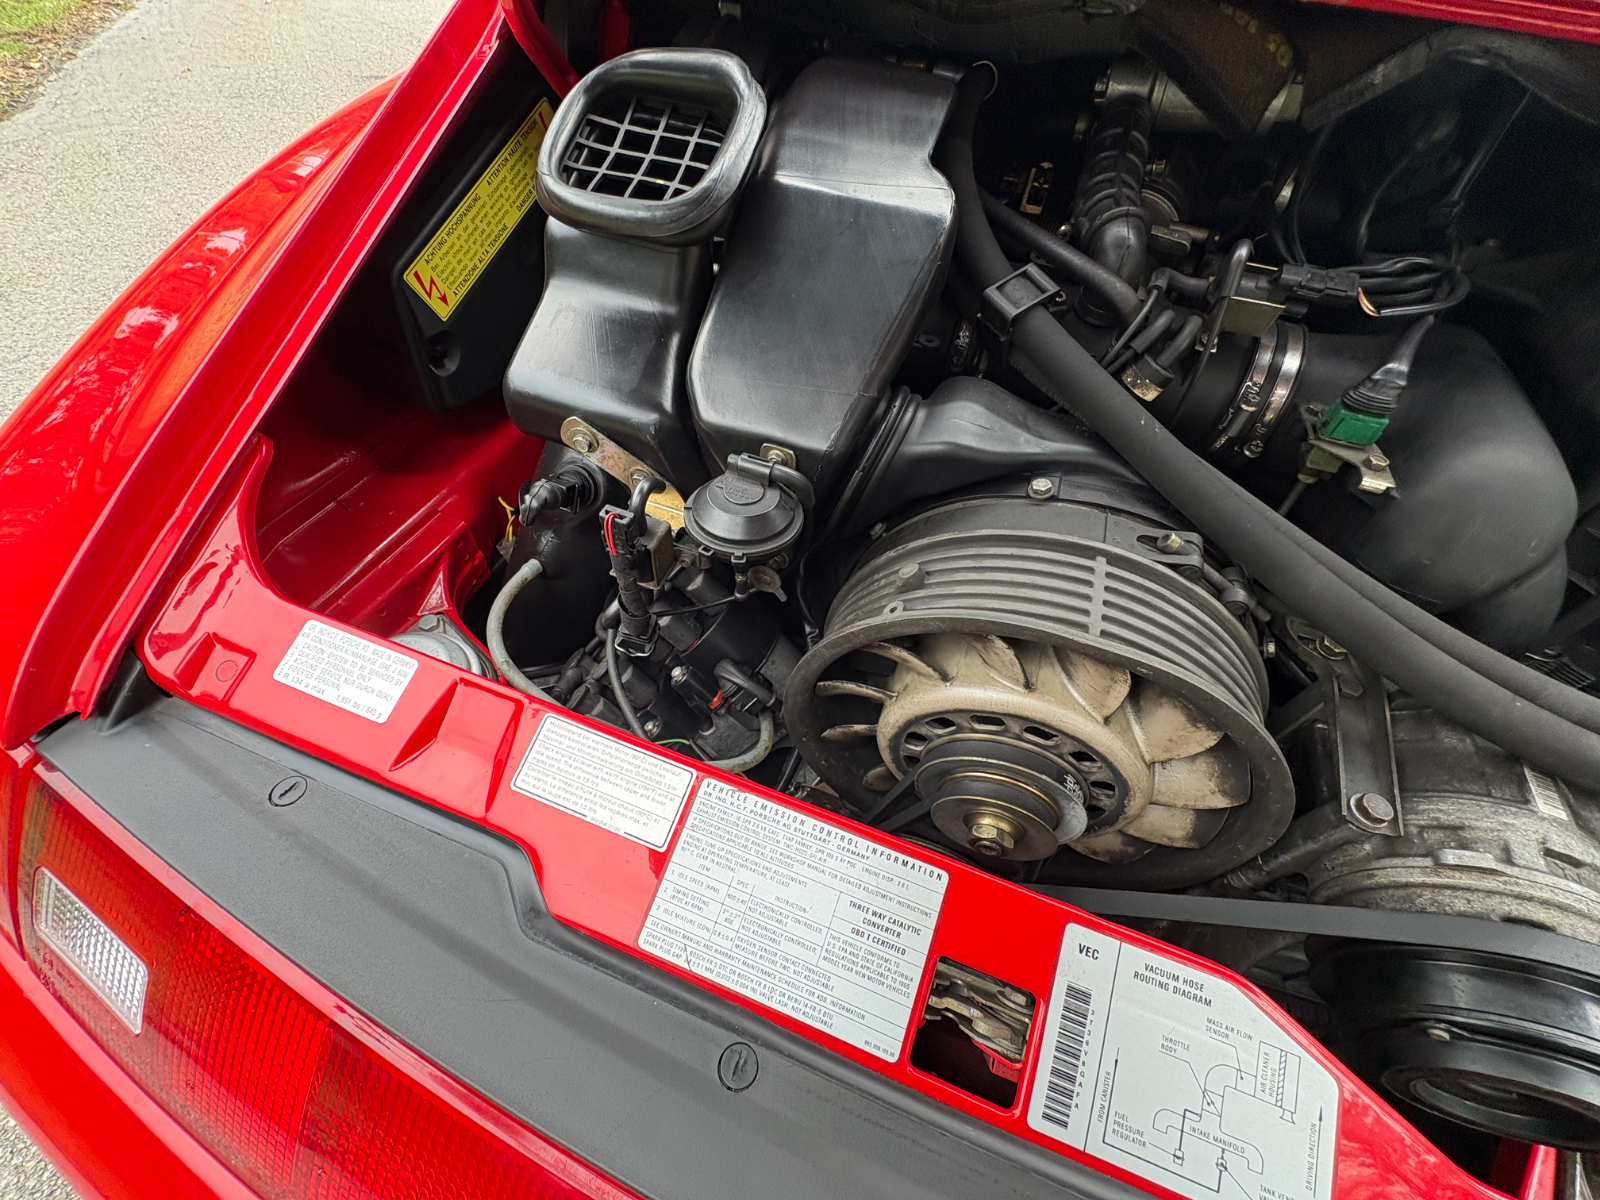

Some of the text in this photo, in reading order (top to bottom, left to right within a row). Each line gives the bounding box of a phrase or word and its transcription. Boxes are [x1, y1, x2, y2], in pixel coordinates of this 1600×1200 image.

[486, 119, 538, 187] ATTENTION HAUTE TENSION
[435, 152, 533, 279] Electric shock suffered when working on ignition can be
[516, 189, 533, 212] DANGER
[424, 193, 481, 265] ACHTUNG HOCHSPANNUNG
[430, 262, 439, 272] Bei
[439, 241, 456, 262] Arbeiten
[455, 233, 463, 241] an
[469, 200, 487, 224] gesamten
[452, 223, 508, 297] ATTENZIONE ALTA TENSIONE
[297, 649, 324, 664] QUALIFIED
[324, 660, 355, 677] PERSONNEL
[356, 672, 372, 683] ONLY
[339, 635, 415, 670] PORSCHE AG MADE IN GERMANY
[282, 672, 290, 680] R
[290, 676, 303, 685] 134
[310, 685, 325, 695] max
[287, 664, 341, 691] FIZIERTES PERSONAL
[319, 667, 343, 681] SERVICE
[343, 676, 356, 686] NUR
[355, 682, 376, 694] DURCH
[327, 652, 349, 664] SYSTEM
[349, 660, 358, 669] TO
[358, 664, 367, 672] BE
[367, 668, 394, 683] SERVICED
[394, 678, 404, 686] BY
[351, 700, 361, 710] lbs
[531, 756, 547, 766] marks
[555, 766, 575, 777] dipstick
[534, 749, 545, 757] idle
[563, 760, 572, 768] The
[573, 765, 599, 779] difference
[600, 776, 622, 788] between
[623, 786, 639, 795] upper
[650, 796, 666, 806] lower
[538, 742, 554, 752] Check
[555, 750, 572, 760] engine
[579, 759, 593, 768] level
[604, 771, 619, 779] warm
[619, 776, 637, 787] engine
[706, 781, 942, 881] VEHICLE EMISSION CONTROL INFORMATION
[749, 809, 831, 845] PORSCHE AG STUTTGART
[690, 822, 725, 841] SPECIFICATIONS
[725, 837, 752, 852] APPLICABLE
[759, 851, 768, 859] ALL
[769, 855, 794, 869] ALTITUDES
[836, 844, 870, 860] GERMANY
[683, 839, 701, 851] ENGINE
[707, 849, 733, 864] OPERATING
[775, 877, 790, 888] LEAST
[849, 900, 921, 935] THREE WAY CATALYTIC
[862, 917, 901, 938] CONVERTER
[650, 919, 713, 952] SEE OWNERS MANUAL AND
[829, 933, 900, 968] THIS VEHICLE CONFORMS TO
[850, 927, 865, 938] OBD
[872, 936, 906, 955] CERTIFIED
[1078, 943, 1099, 960] VEC
[822, 955, 840, 967] MODEL
[841, 963, 854, 973] YEAR
[854, 969, 867, 979] NEW
[866, 974, 885, 987] MOTOR
[824, 948, 897, 984] REGULATIONS APPLICABLE TO
[837, 945, 848, 954] EPA
[848, 950, 860, 959] AND
[860, 955, 875, 966] STATE
[883, 965, 913, 982] CALIFORNIA
[1144, 963, 1204, 992] VACUUM HOSE
[777, 976, 804, 993] SCHEDULE
[804, 988, 815, 998] FOR
[829, 1000, 865, 1020] INFORMATION
[1133, 971, 1211, 1007] ROUTING DIAGRAM
[1162, 1035, 1190, 1051] THROTTLE
[1205, 1025, 1229, 1040] SENSOR
[1206, 1017, 1253, 1041] MASS AIR FLOW
[1160, 1043, 1177, 1054] BODY
[1260, 1051, 1269, 1081] CLEANER
[1097, 1071, 1111, 1123] FROM CANISTER
[1268, 1067, 1277, 1098] HOUSING
[1113, 1119, 1144, 1138] PRESSURE
[1114, 1111, 1128, 1123] FUEL
[1111, 1128, 1146, 1148] REGULATOR
[1189, 1125, 1245, 1154] INTAKE MANIFOLD
[1305, 1123, 1317, 1191] DRIVING DIRECTION
[1260, 1184, 1276, 1197] TANK
